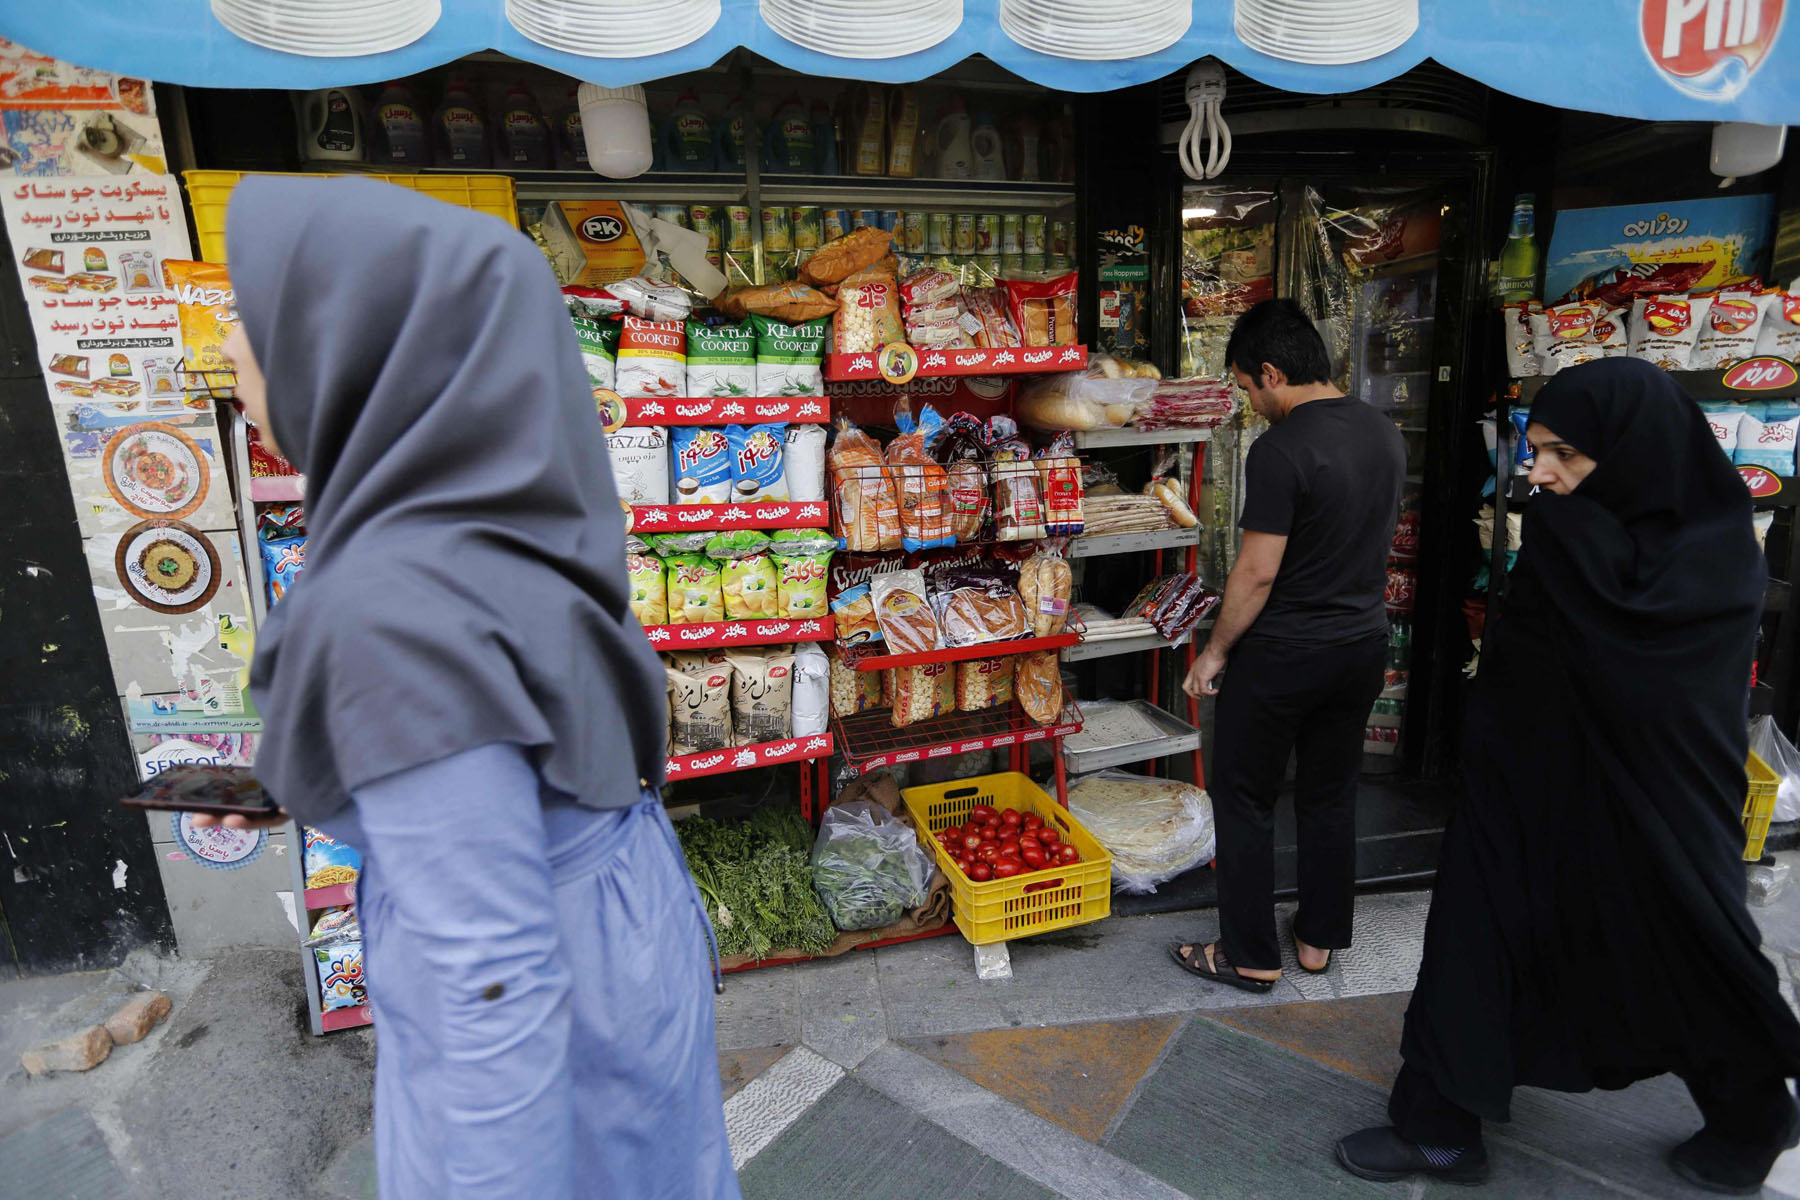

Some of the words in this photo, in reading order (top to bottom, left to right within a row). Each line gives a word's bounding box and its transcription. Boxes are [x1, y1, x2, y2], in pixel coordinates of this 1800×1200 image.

[15, 183, 66, 199] ستاک
[71, 186, 95, 203] جو
[100, 181, 167, 202] بیسکویت
[22, 211, 62, 229] رسید
[65, 206, 100, 228] توت
[105, 206, 155, 224] شهد
[159, 204, 170, 224] با
[1624, 213, 1688, 237] روزانه
[51, 318, 88, 336] رسید
[92, 315, 124, 335] توت
[131, 314, 178, 333] شهد
[767, 323, 824, 339] KETTLE
[631, 332, 679, 346] COOKED
[694, 327, 756, 340] KETTLE
[701, 340, 749, 352] COOKED
[774, 341, 818, 352] COOKED
[955, 353, 986, 366] Chuckles
[1023, 350, 1053, 363] Chuckles
[637, 401, 665, 418] چاکلز
[675, 403, 712, 417] Chuckles
[718, 401, 746, 418] چاکلز
[755, 402, 789, 416] Chuckles
[796, 400, 822, 417] چاکلز
[678, 508, 714, 522] Chuckles
[756, 506, 790, 521] Chuckles
[783, 558, 825, 585] چاکلز
[680, 626, 715, 640] Chuckles
[721, 624, 748, 640] چاکلز
[756, 623, 790, 637] Chuckles
[741, 676, 758, 694] مزه
[751, 672, 771, 700] دل
[688, 683, 709, 709] دل
[765, 742, 797, 757] Chuckles
[803, 736, 827, 752] چاکلز
[690, 754, 725, 769] Chuckles
